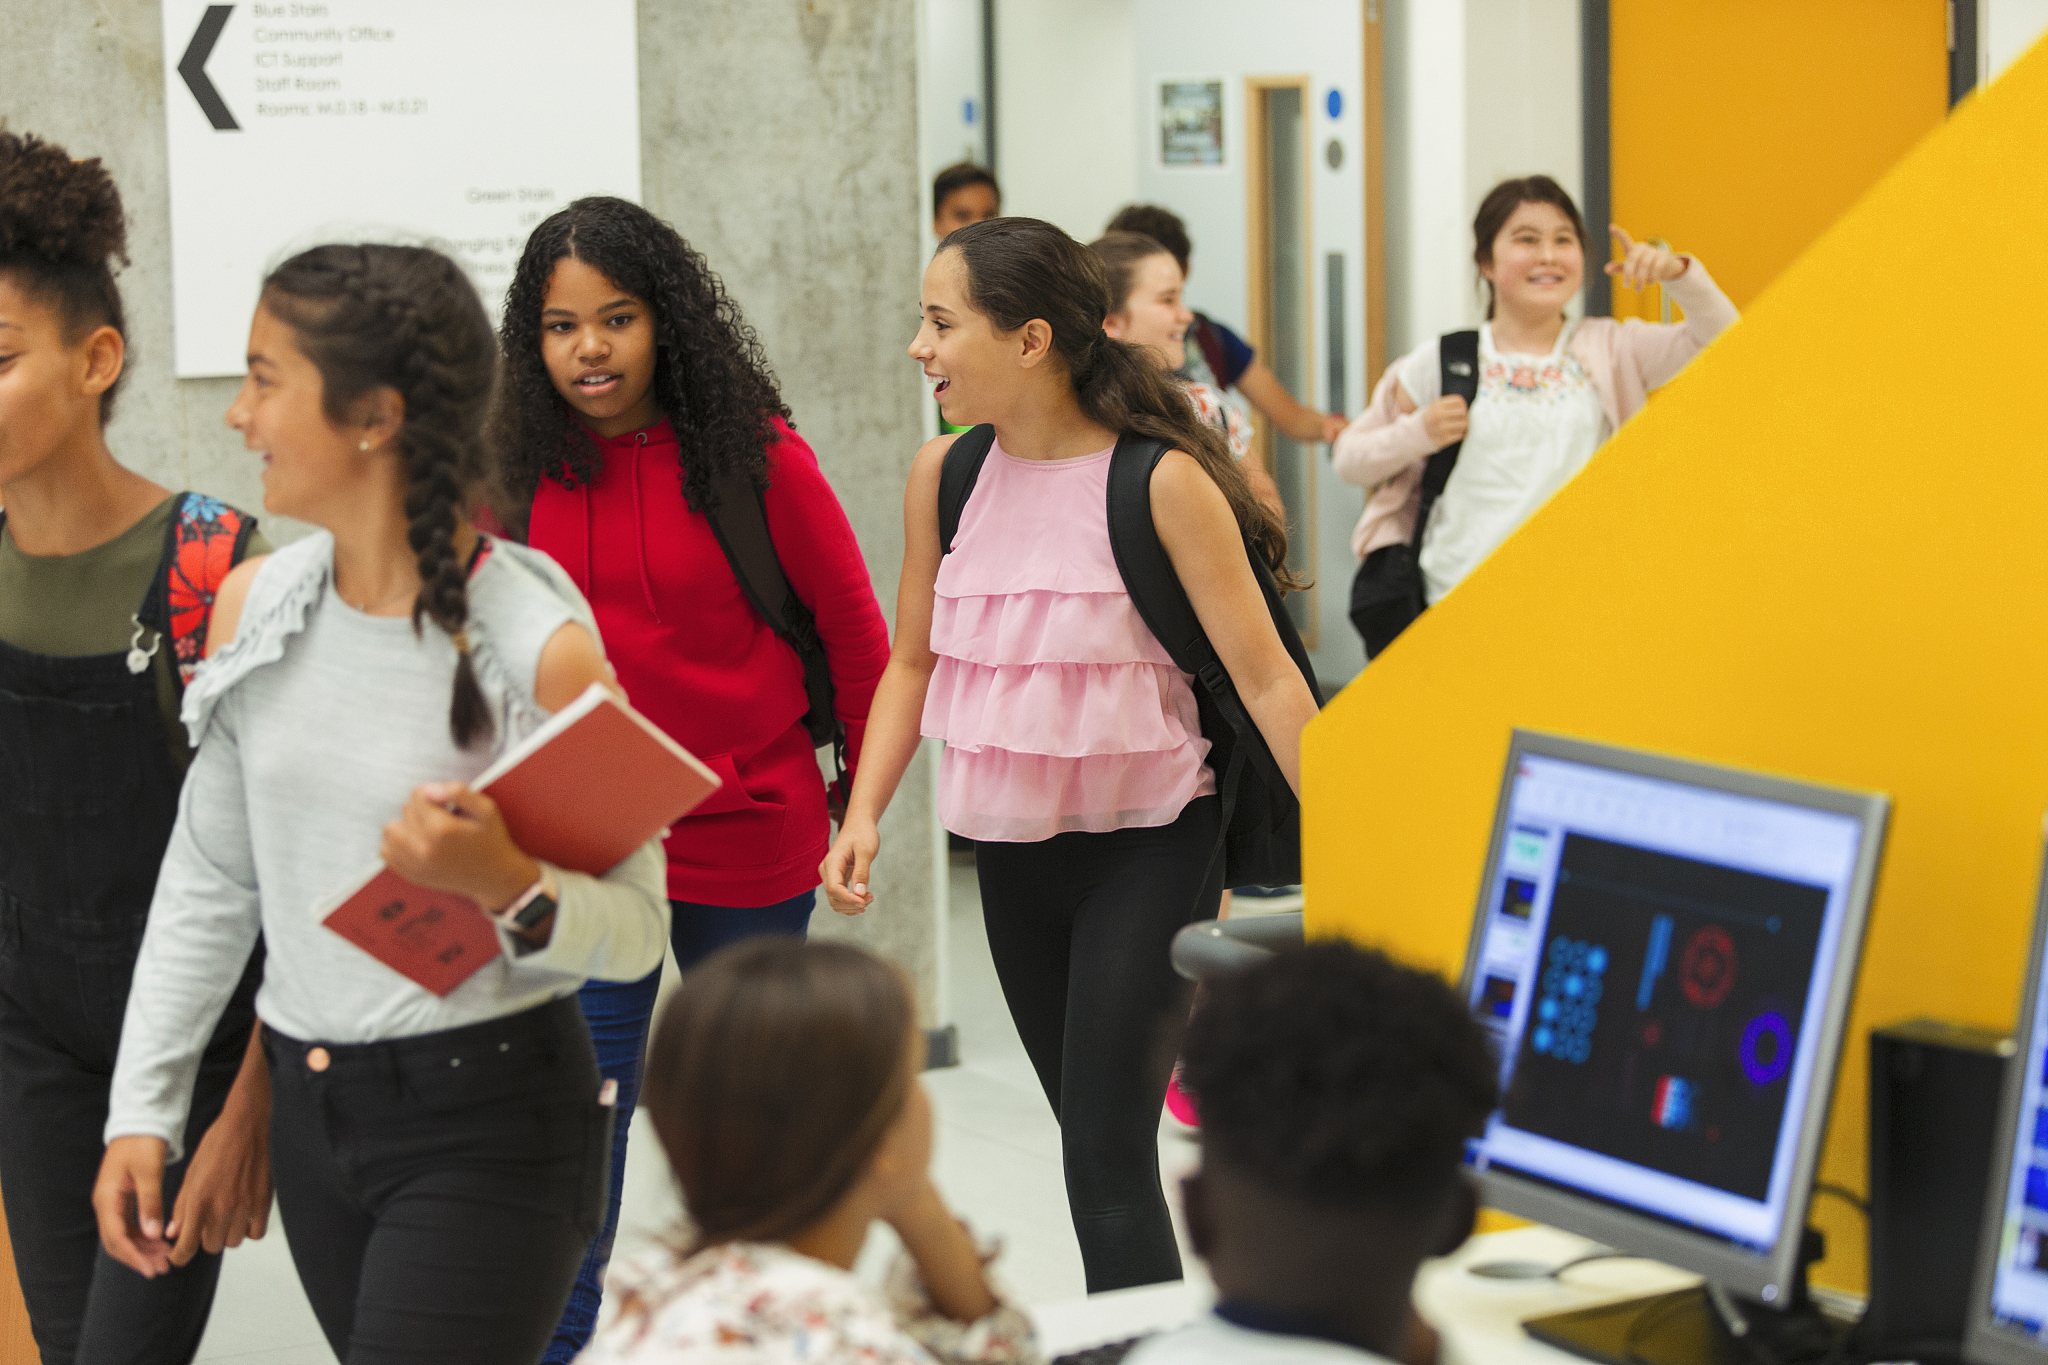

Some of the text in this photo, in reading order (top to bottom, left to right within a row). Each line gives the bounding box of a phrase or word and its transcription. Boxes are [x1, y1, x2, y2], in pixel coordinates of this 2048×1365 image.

[253, 25, 395, 44] Community Office
[282, 52, 343, 69] Support
[255, 76, 341, 92] Staff Room
[466, 186, 513, 203] Green
